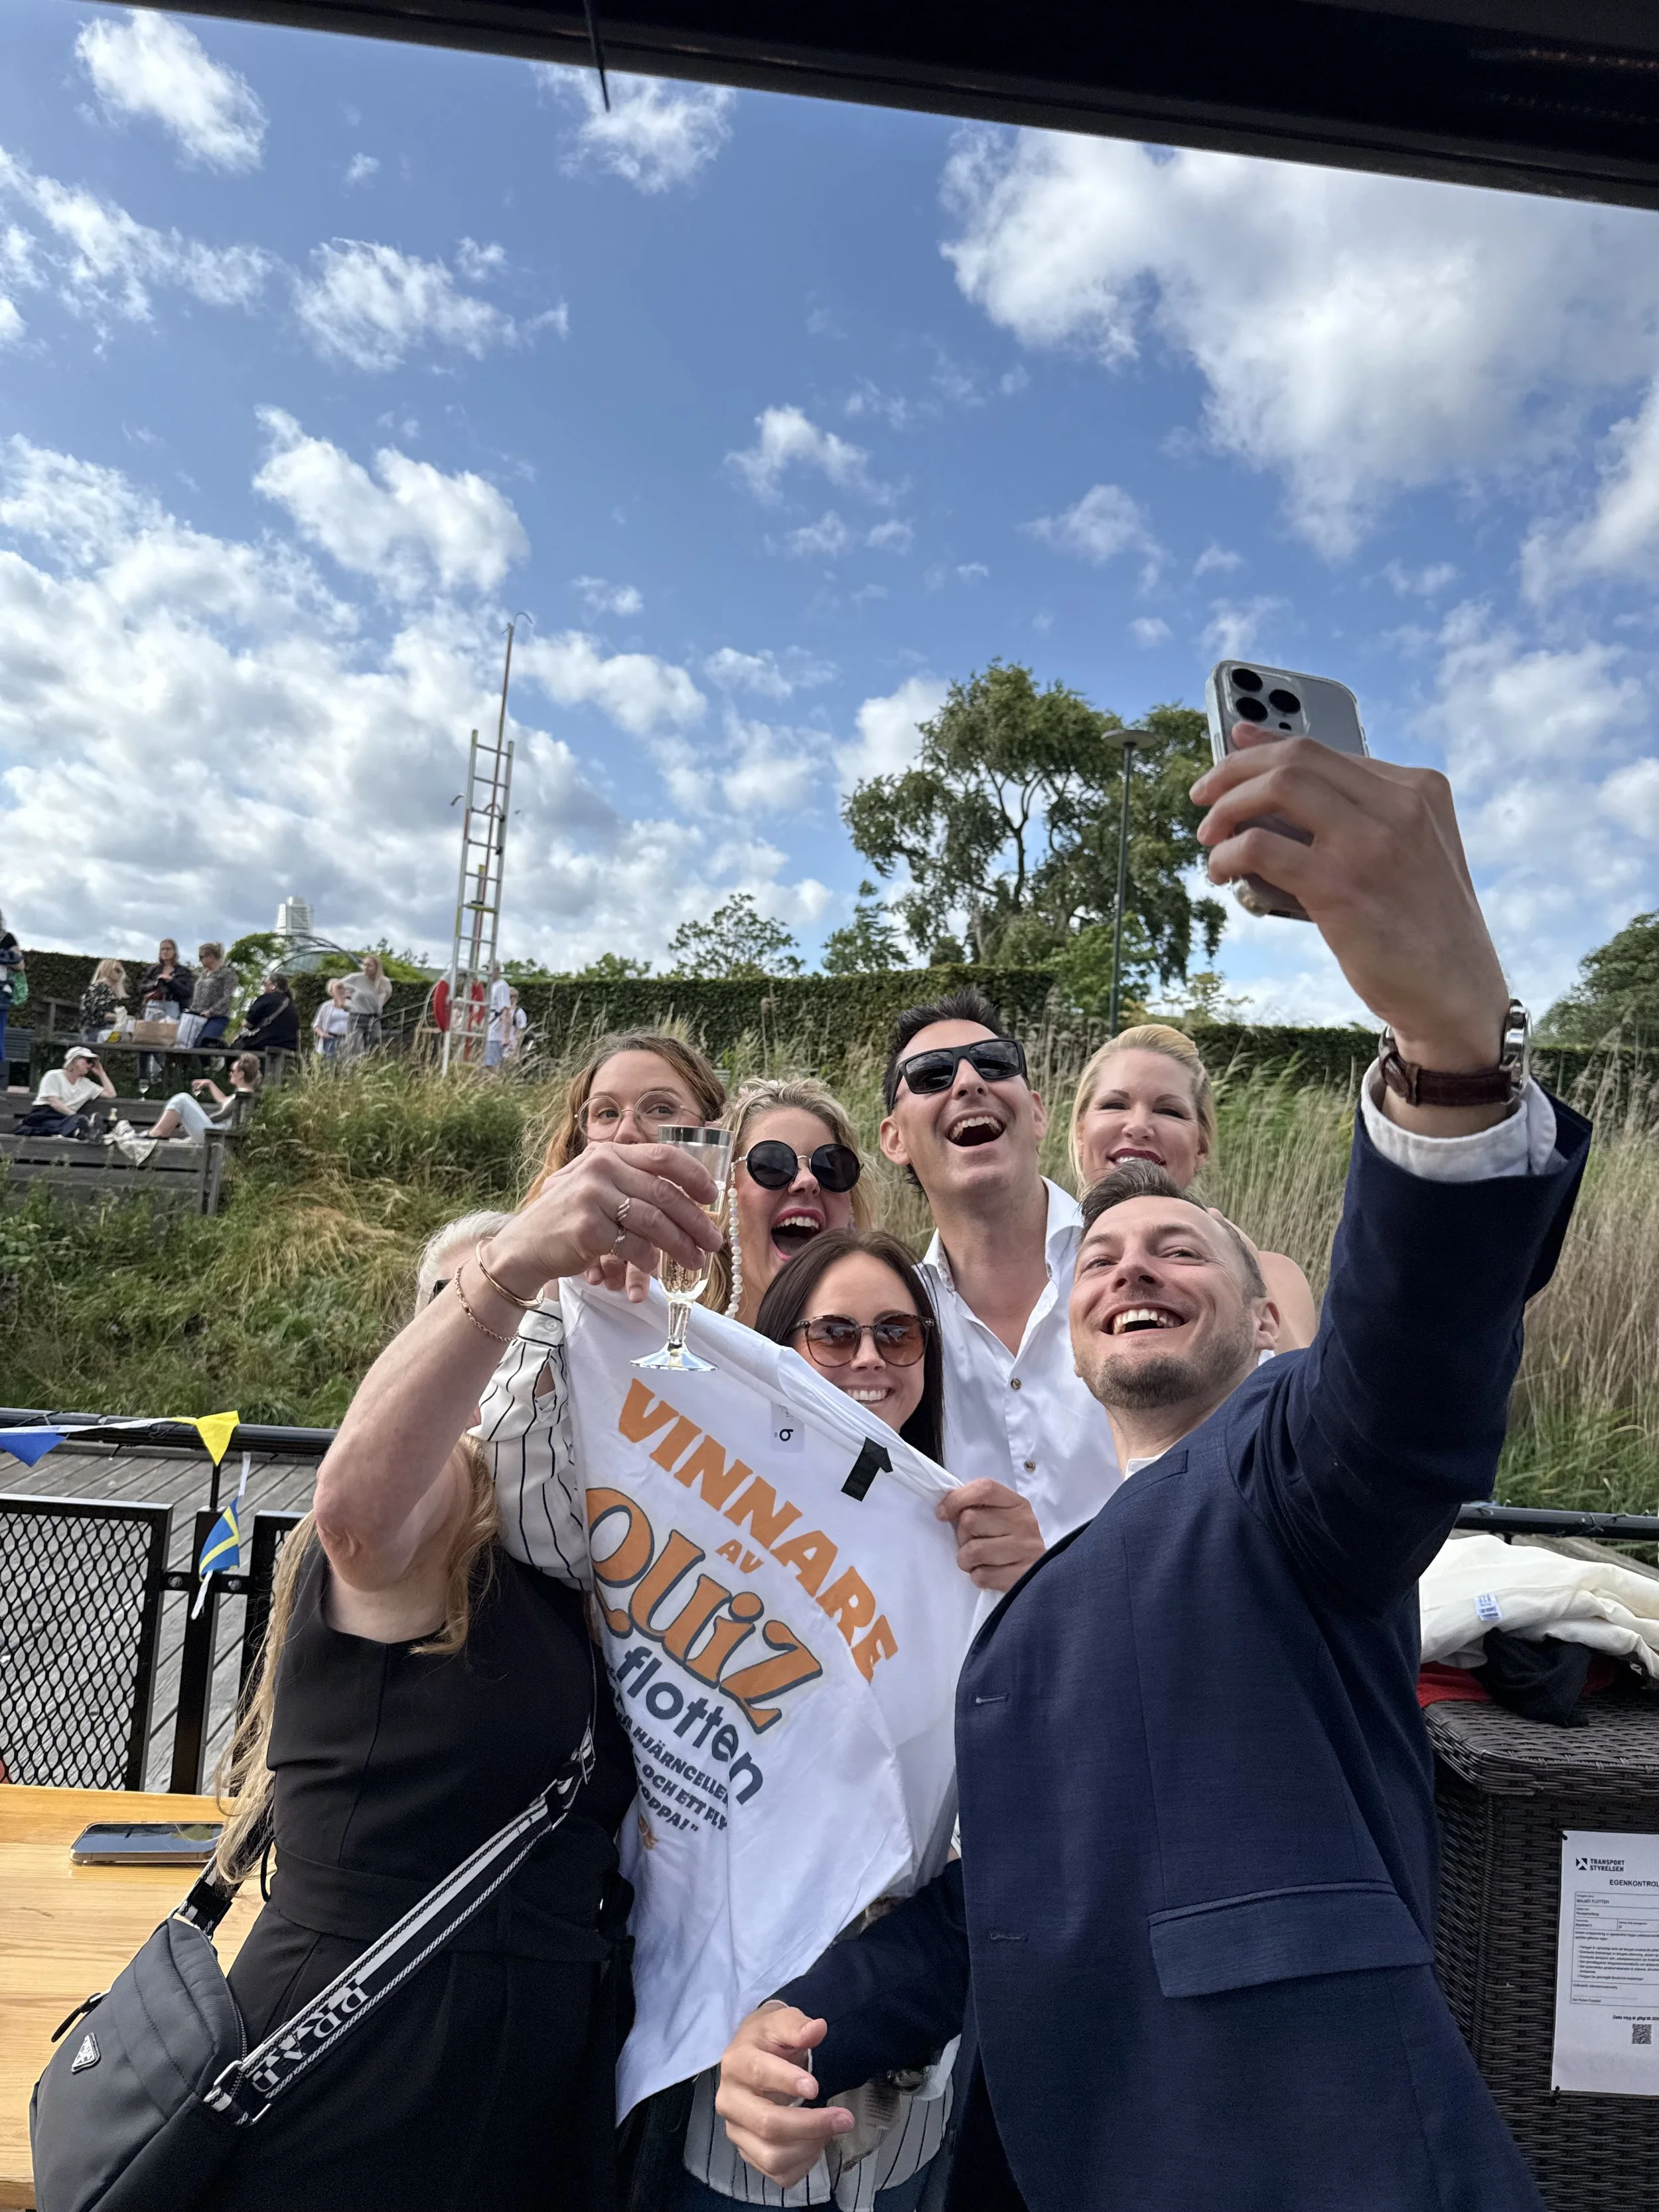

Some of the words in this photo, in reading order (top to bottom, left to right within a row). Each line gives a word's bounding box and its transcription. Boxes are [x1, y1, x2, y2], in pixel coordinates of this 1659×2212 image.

[618, 1378, 899, 1684] VINNARE
[715, 1539, 764, 1574] AV
[616, 1646, 764, 1805] flotten
[642, 1763, 678, 1797] OCH
[674, 1788, 708, 1815] ETT
